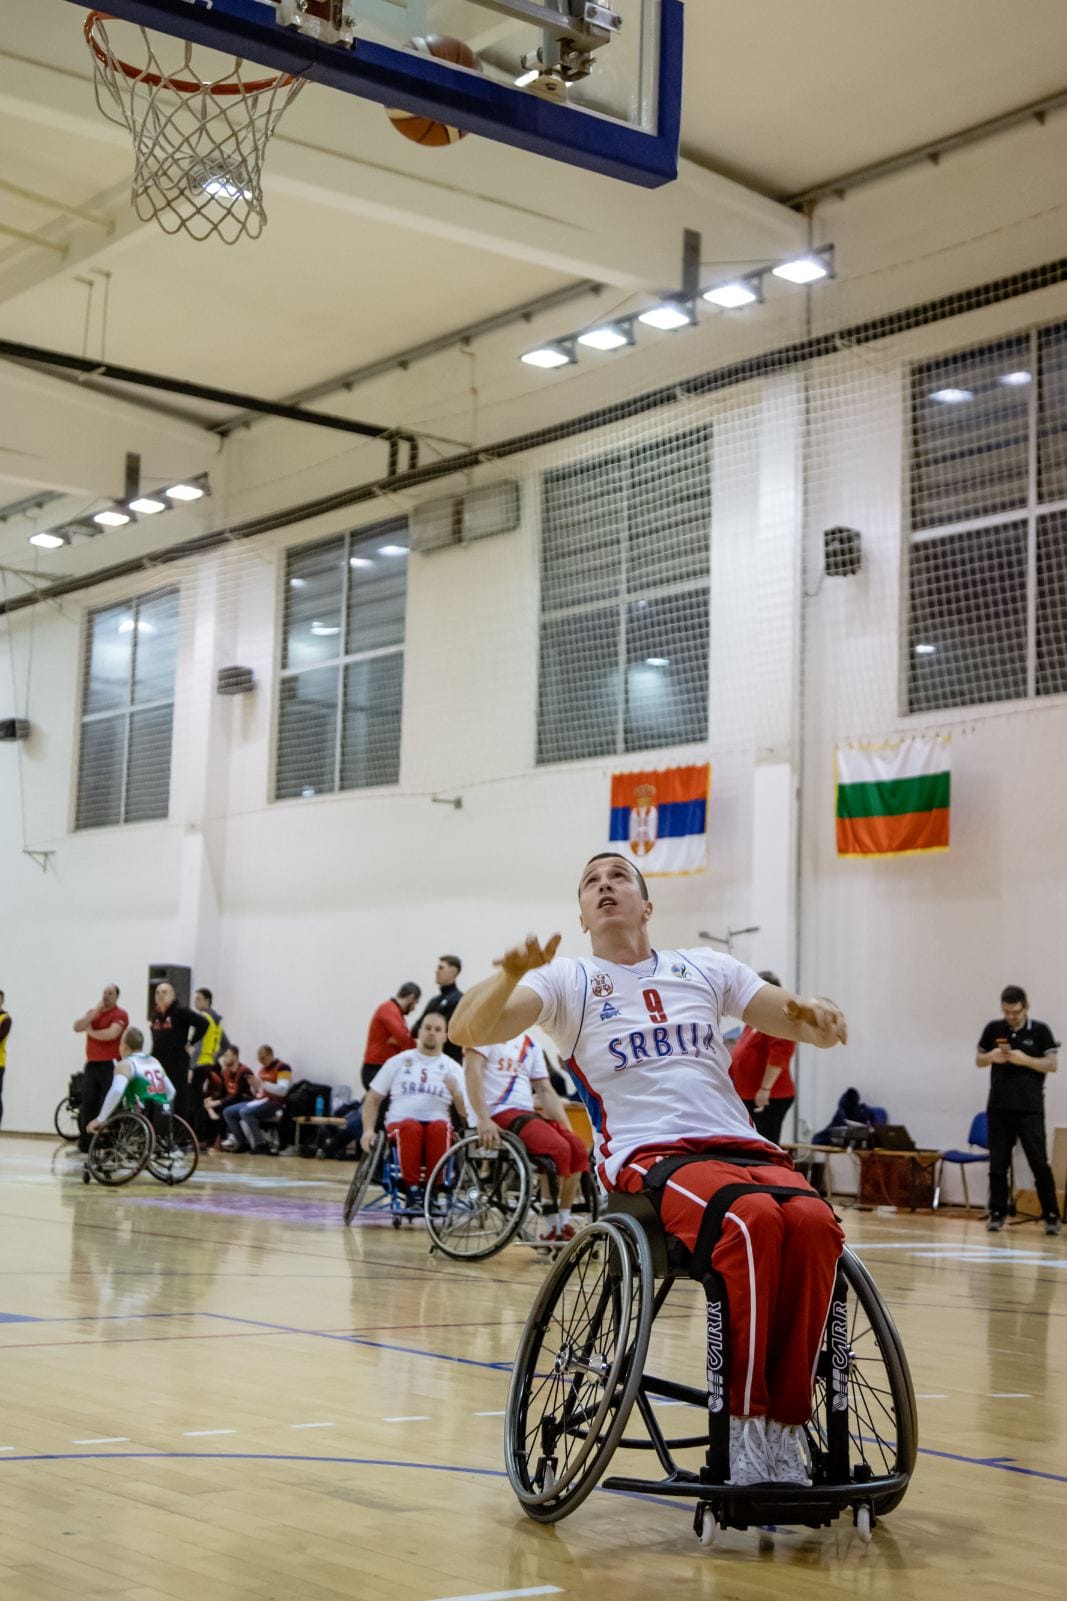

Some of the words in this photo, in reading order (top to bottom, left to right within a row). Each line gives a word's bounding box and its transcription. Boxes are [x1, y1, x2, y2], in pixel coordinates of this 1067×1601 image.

[642, 988, 668, 1024] 9
[144, 1070, 166, 1093] 35
[420, 1068, 428, 1083] 5
